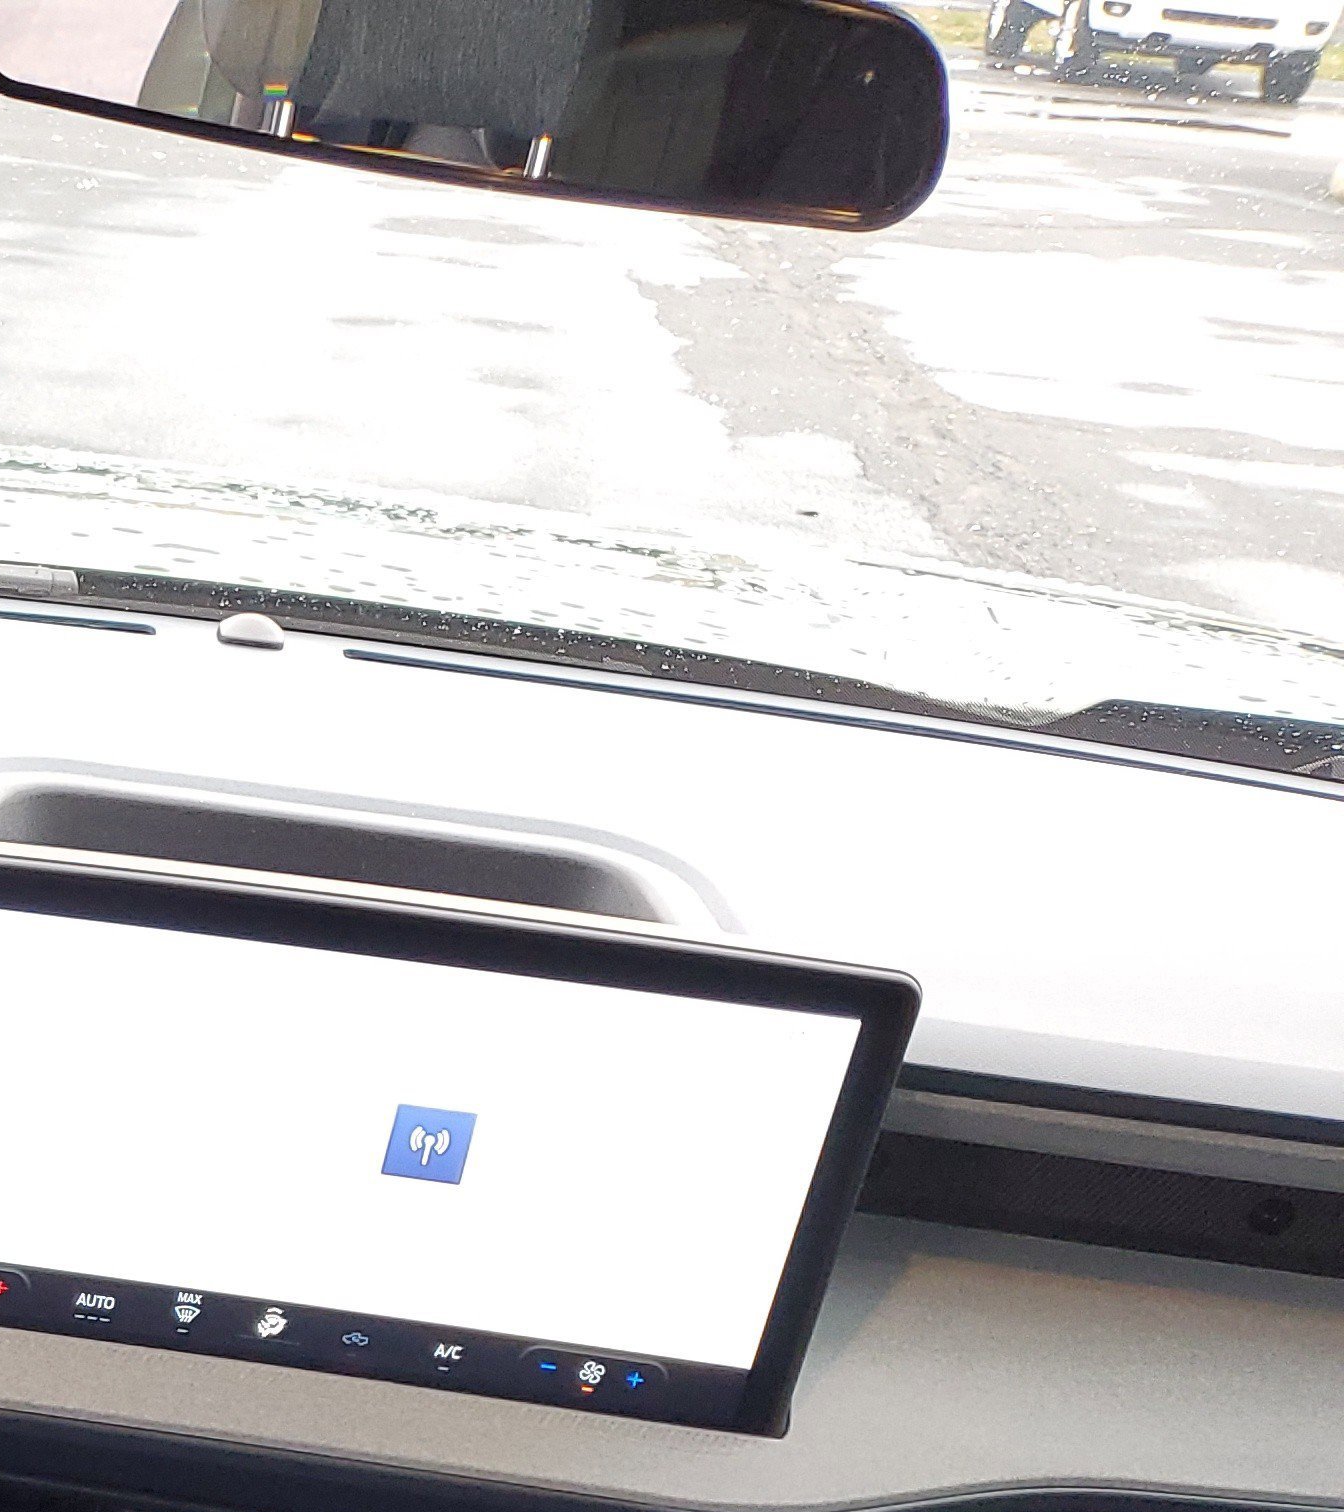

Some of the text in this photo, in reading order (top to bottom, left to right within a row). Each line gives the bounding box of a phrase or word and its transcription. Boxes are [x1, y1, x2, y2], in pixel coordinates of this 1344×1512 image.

[75, 1292, 116, 1310] AUTO
[177, 1291, 203, 1306] MAX
[433, 1342, 464, 1360] A/C
